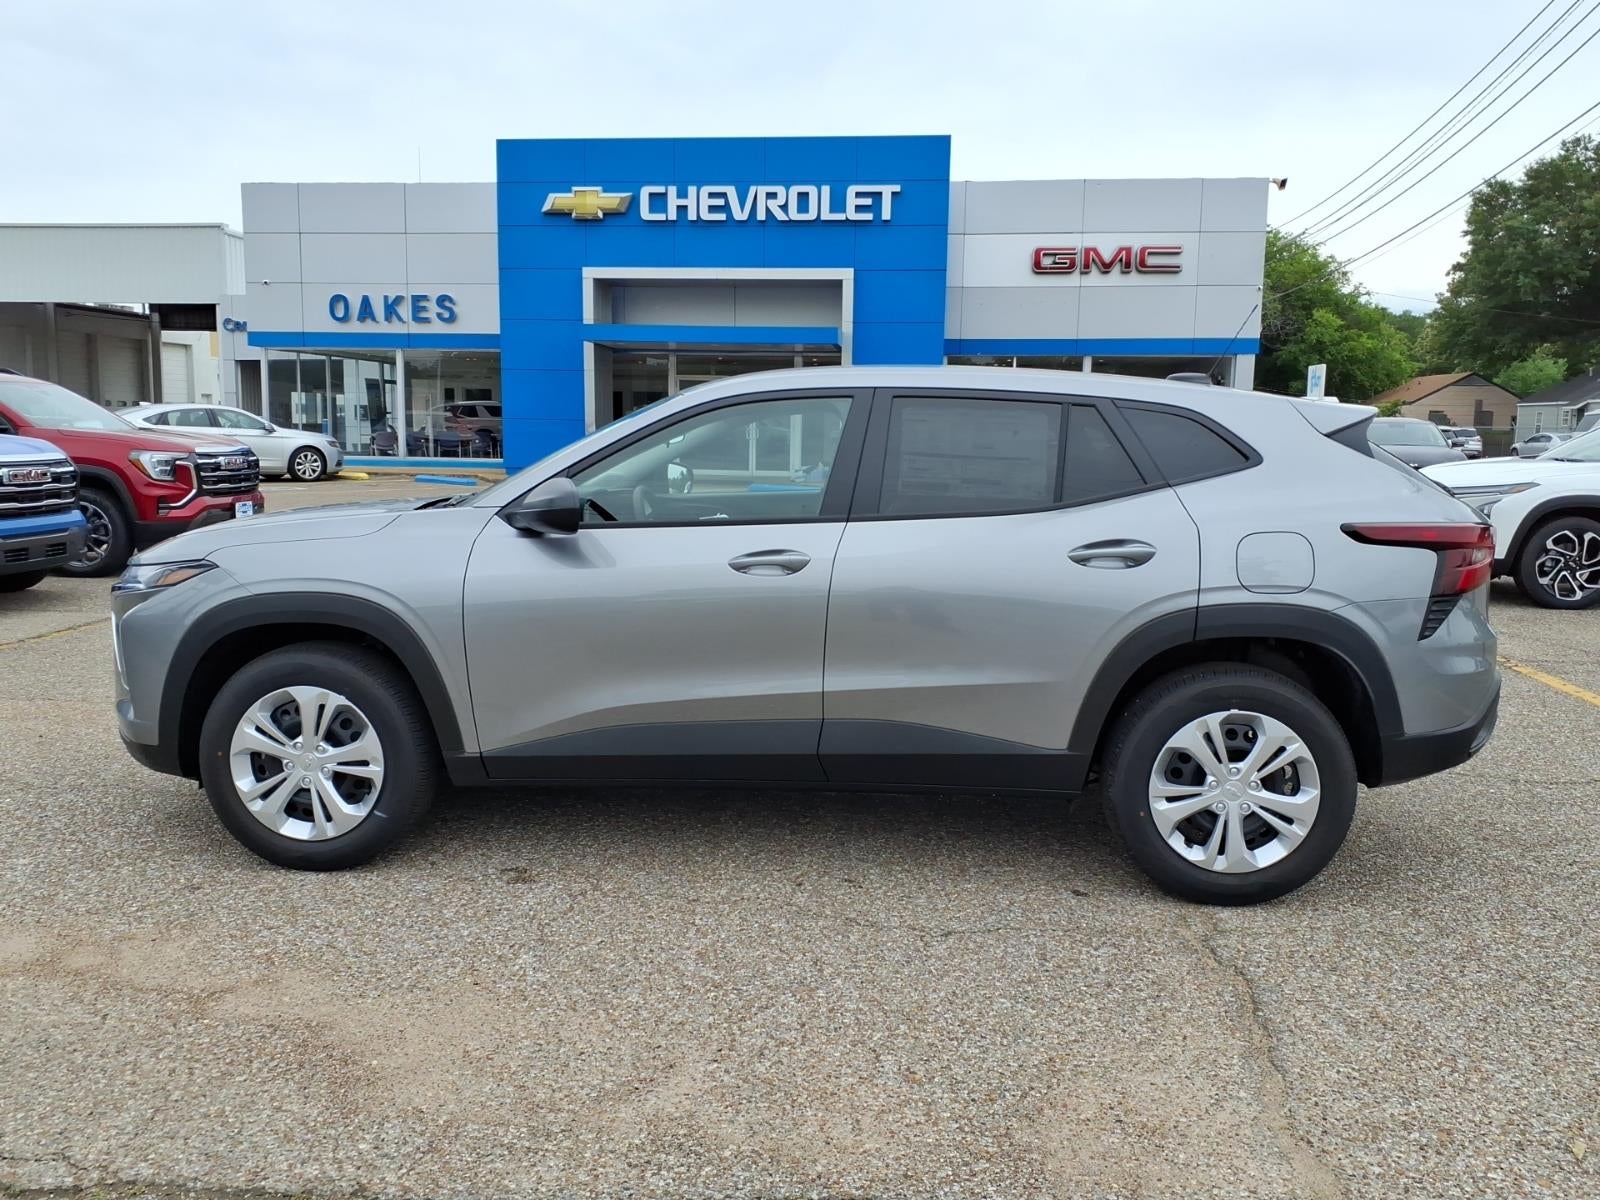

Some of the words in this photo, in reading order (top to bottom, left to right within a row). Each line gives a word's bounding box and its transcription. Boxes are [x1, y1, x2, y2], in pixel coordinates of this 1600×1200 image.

[640, 184, 901, 221] CHEVROLET
[1032, 245, 1183, 273] GMC
[328, 293, 458, 323] OAKES
[9, 469, 52, 482] GMC
